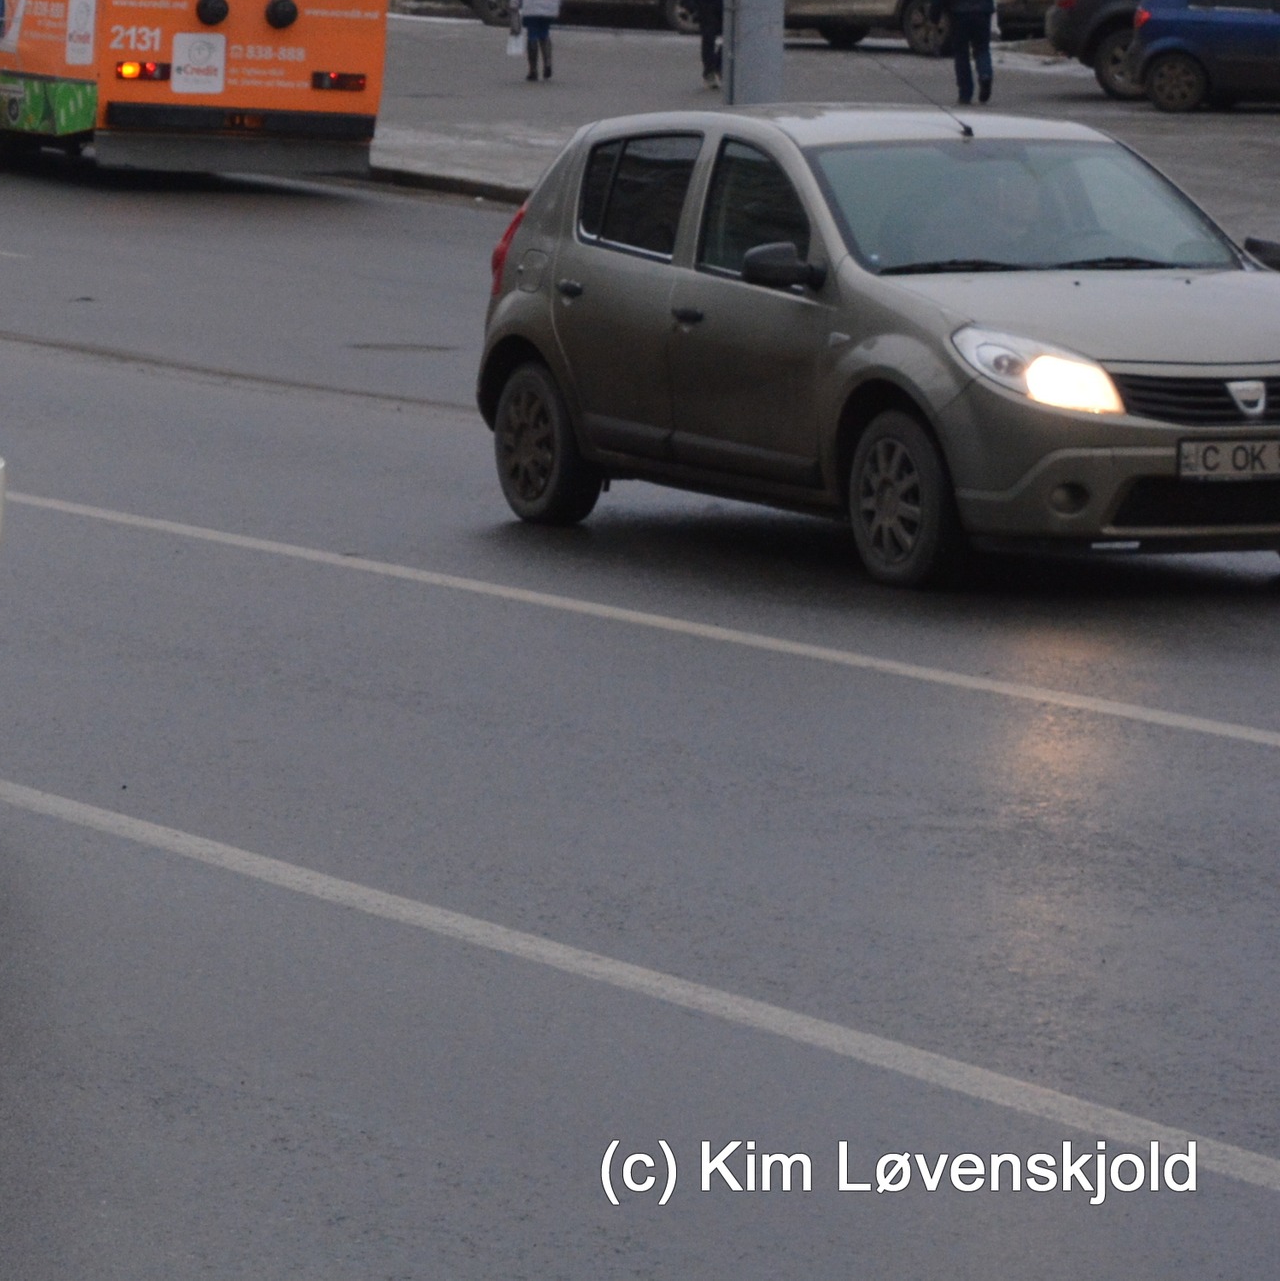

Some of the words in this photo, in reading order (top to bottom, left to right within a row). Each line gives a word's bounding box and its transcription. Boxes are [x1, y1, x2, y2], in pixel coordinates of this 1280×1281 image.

[109, 24, 161, 52] 2131
[1202, 445, 1220, 471] C
[1232, 444, 1266, 471] OK
